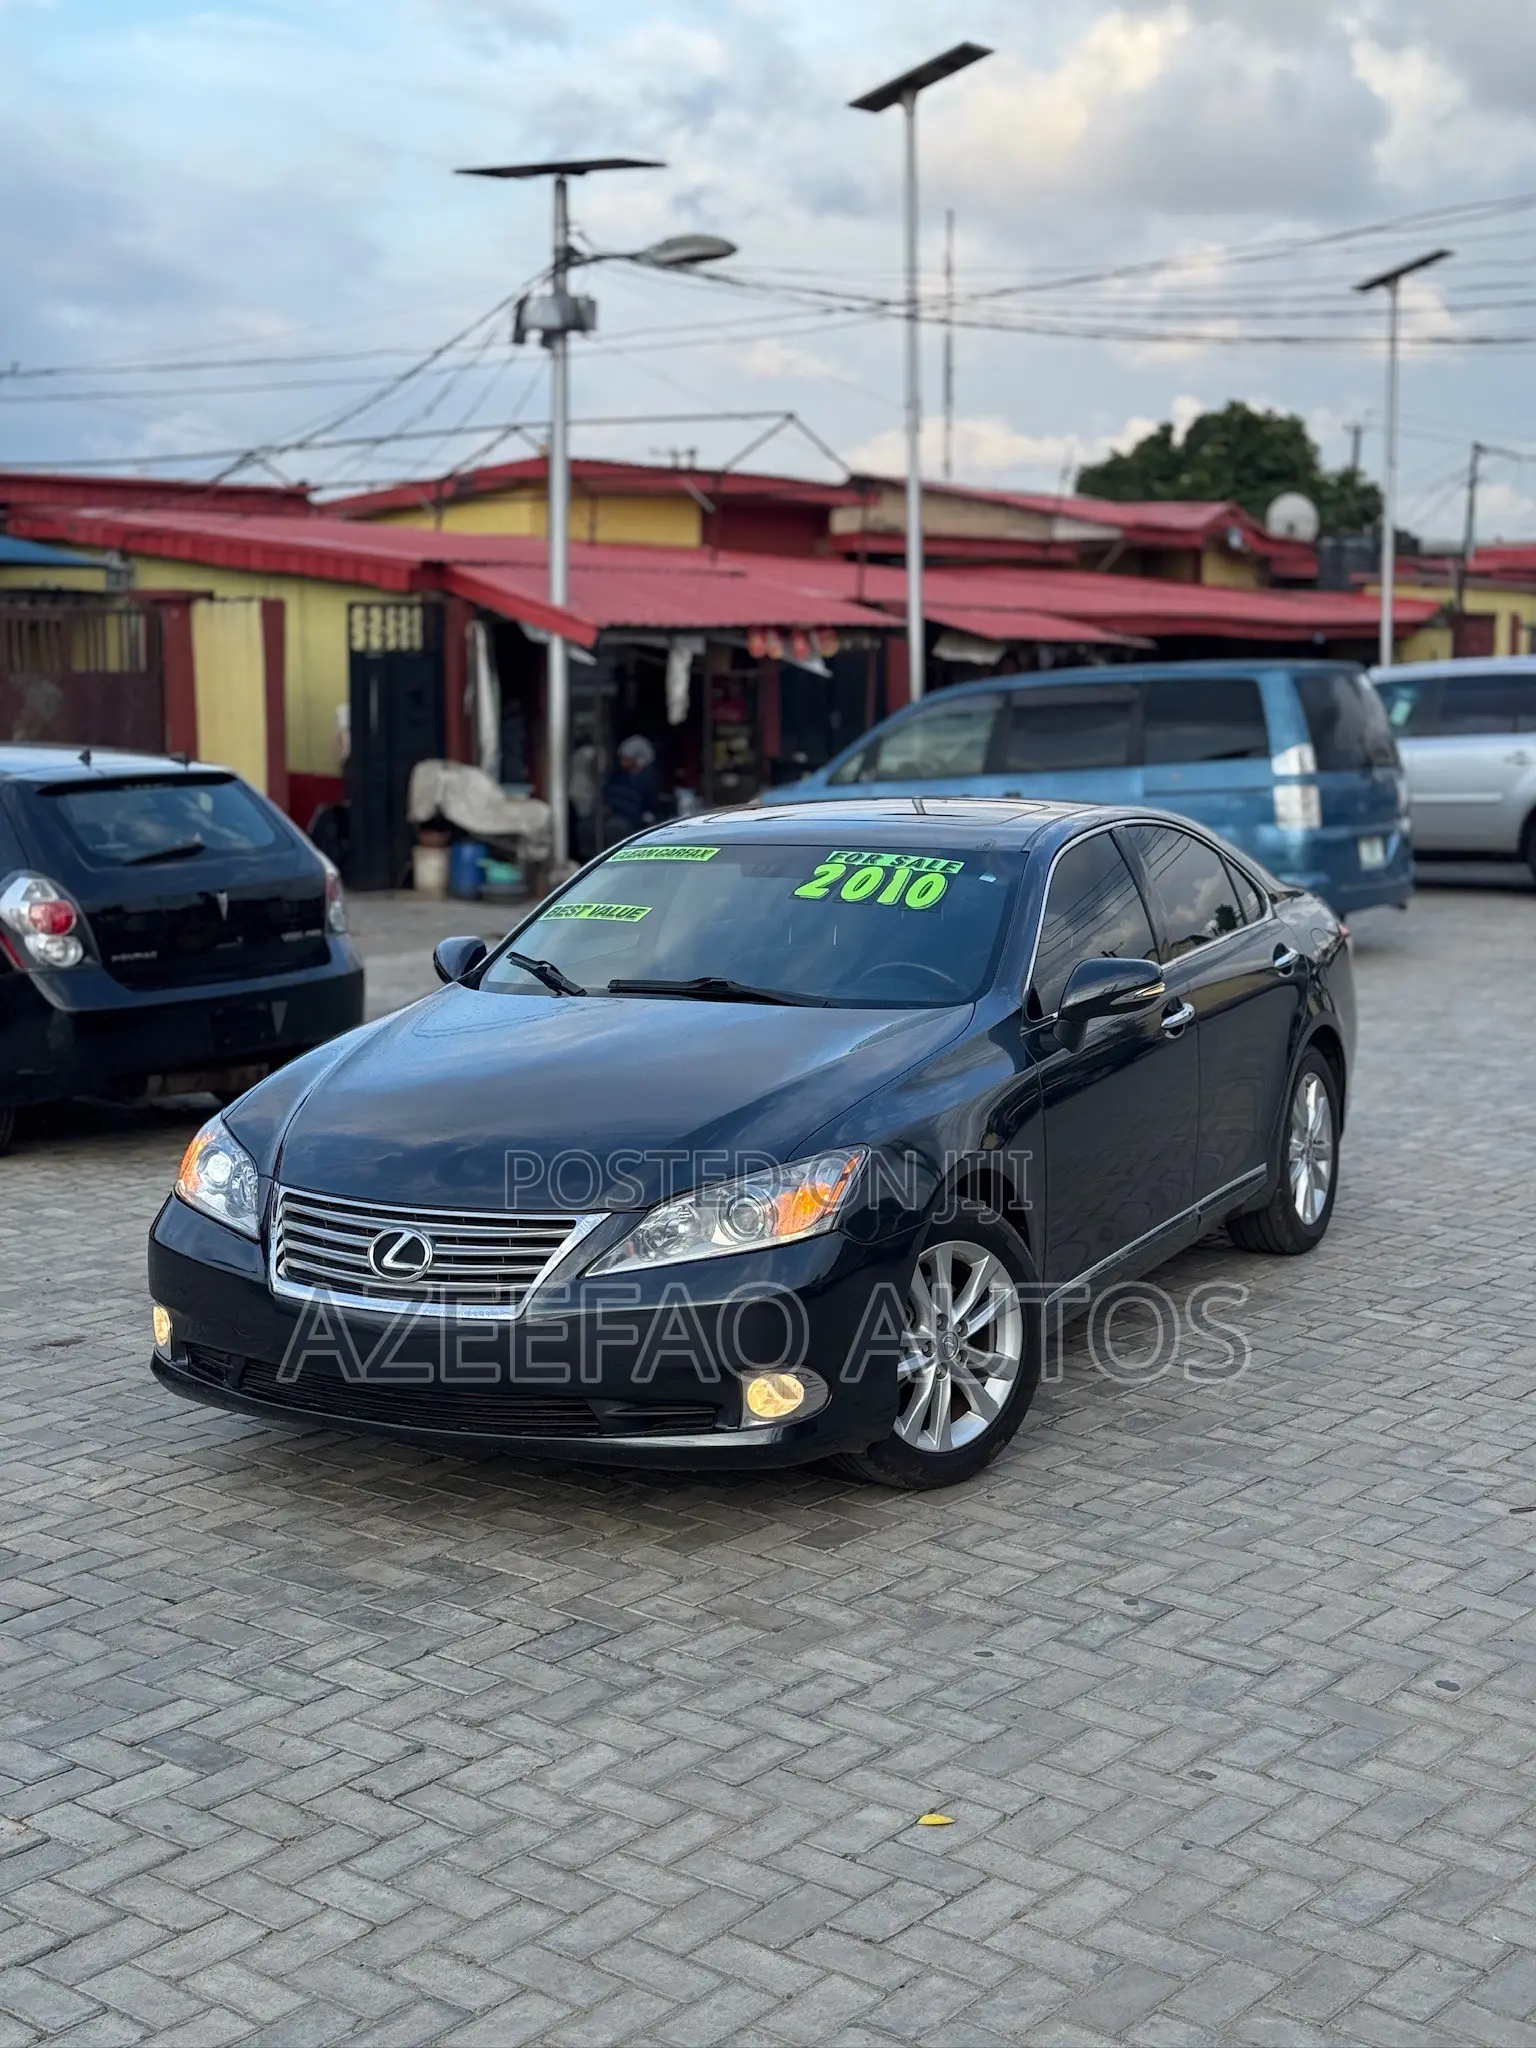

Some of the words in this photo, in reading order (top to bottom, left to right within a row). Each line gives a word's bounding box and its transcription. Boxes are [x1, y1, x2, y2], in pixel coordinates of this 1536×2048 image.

[828, 851, 884, 865] FOR
[890, 855, 962, 873] SALE
[794, 863, 948, 910] 2010
[545, 904, 589, 919] BEST
[588, 905, 648, 920] VALUE
